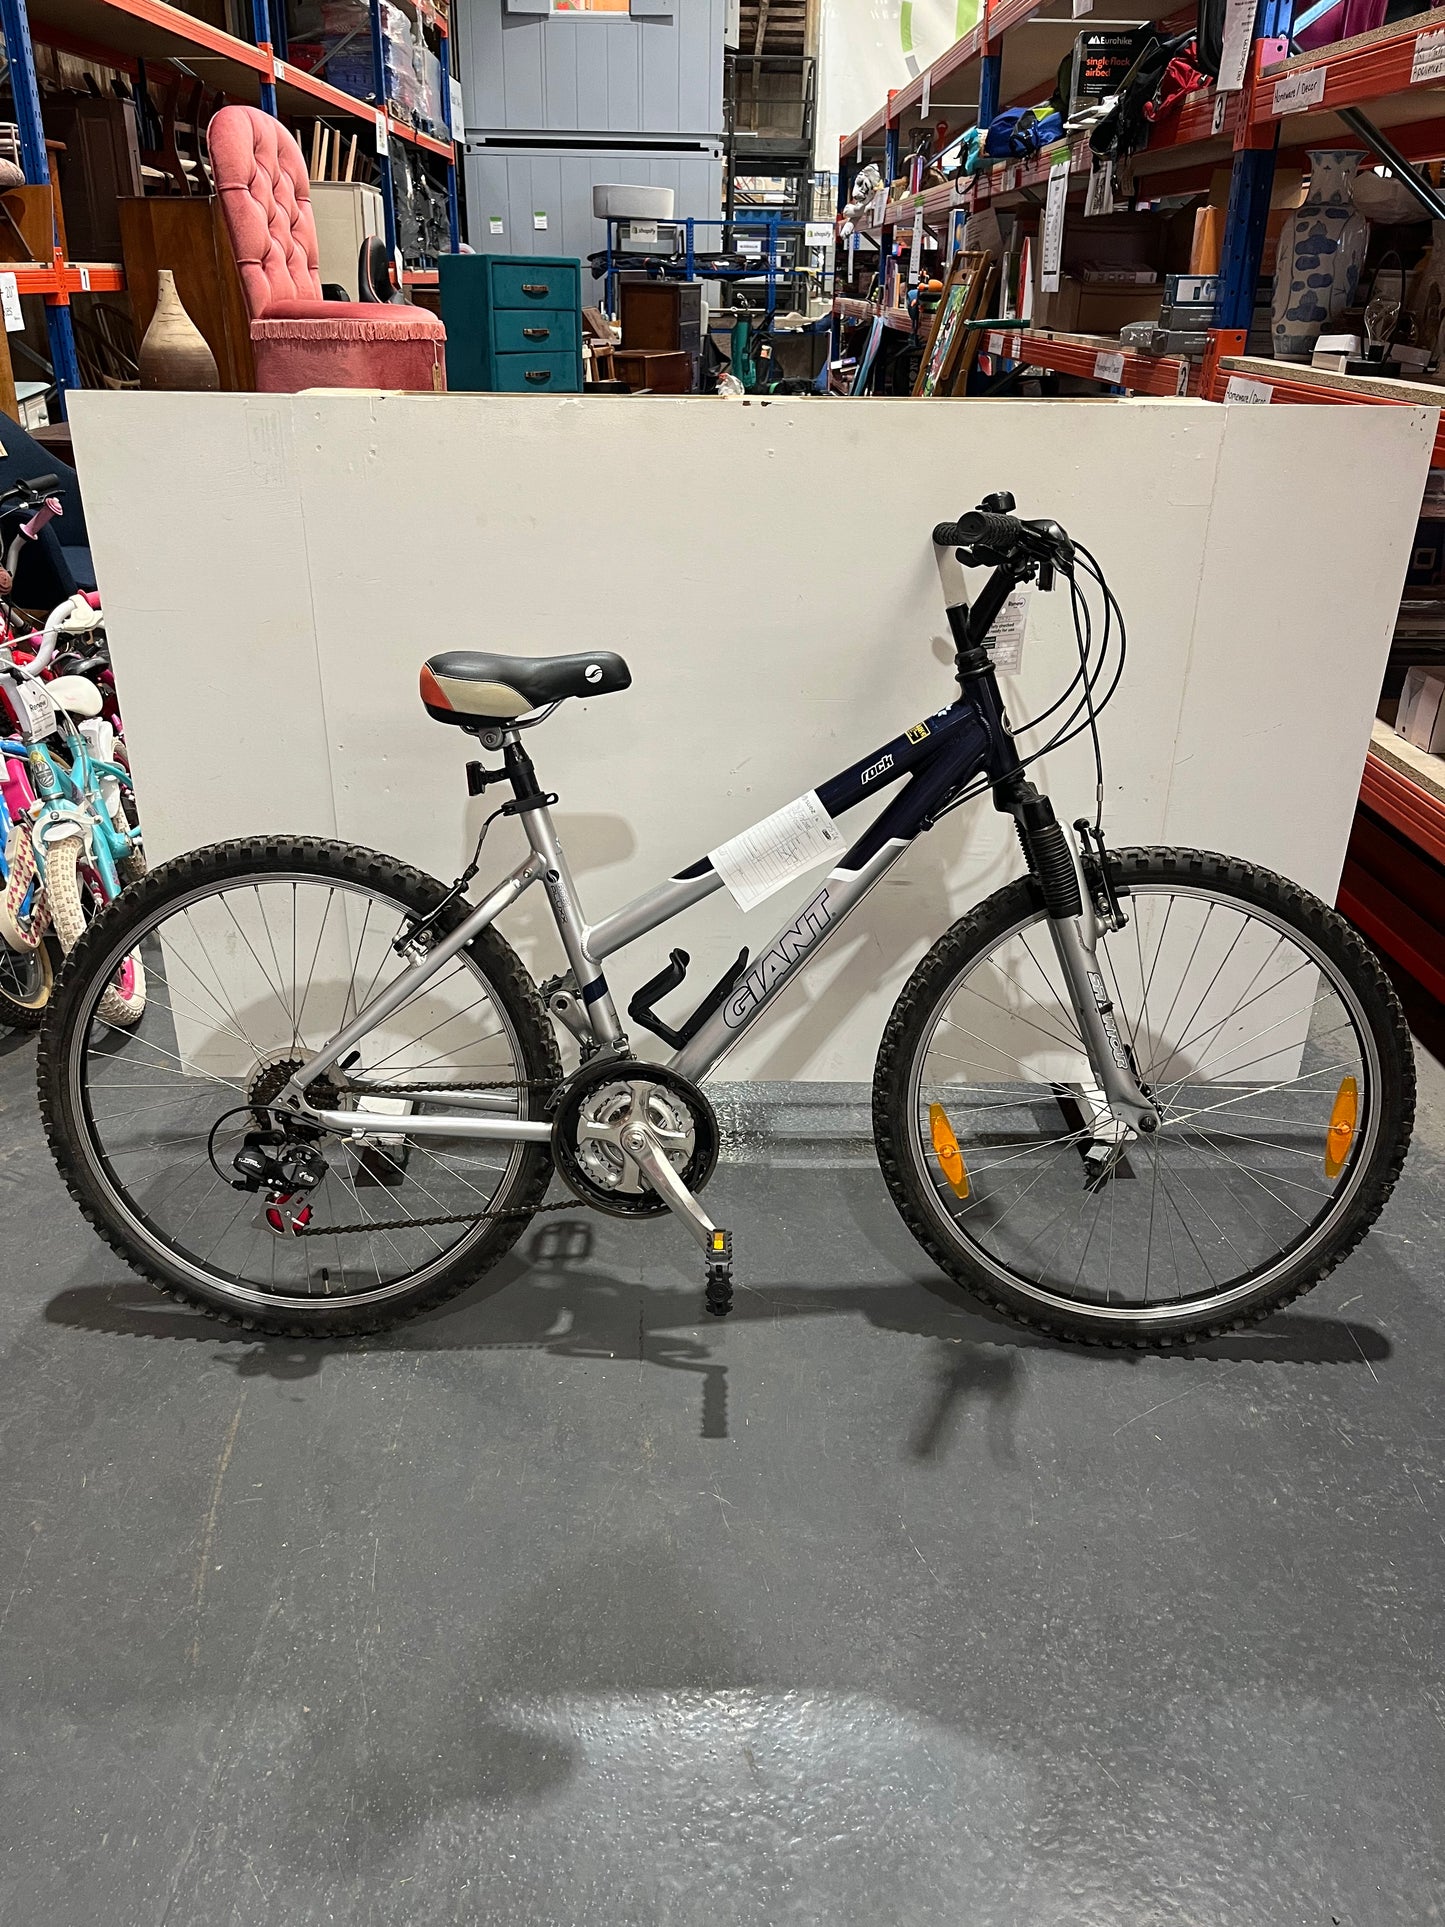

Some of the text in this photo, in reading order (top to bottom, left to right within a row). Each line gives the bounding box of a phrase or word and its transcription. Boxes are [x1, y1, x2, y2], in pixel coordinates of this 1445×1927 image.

[1100, 36, 1133, 45] Eurohike
[1086, 56, 1130, 69] single flock
[1085, 67, 1111, 77] airbed
[1214, 95, 1223, 130] 3
[638, 227, 656, 235] shopify
[82, 270, 88, 289] 1
[1178, 366, 1187, 397] 2
[29, 701, 47, 712] Renew
[861, 753, 895, 785] rock
[723, 887, 833, 1029] GIANT
